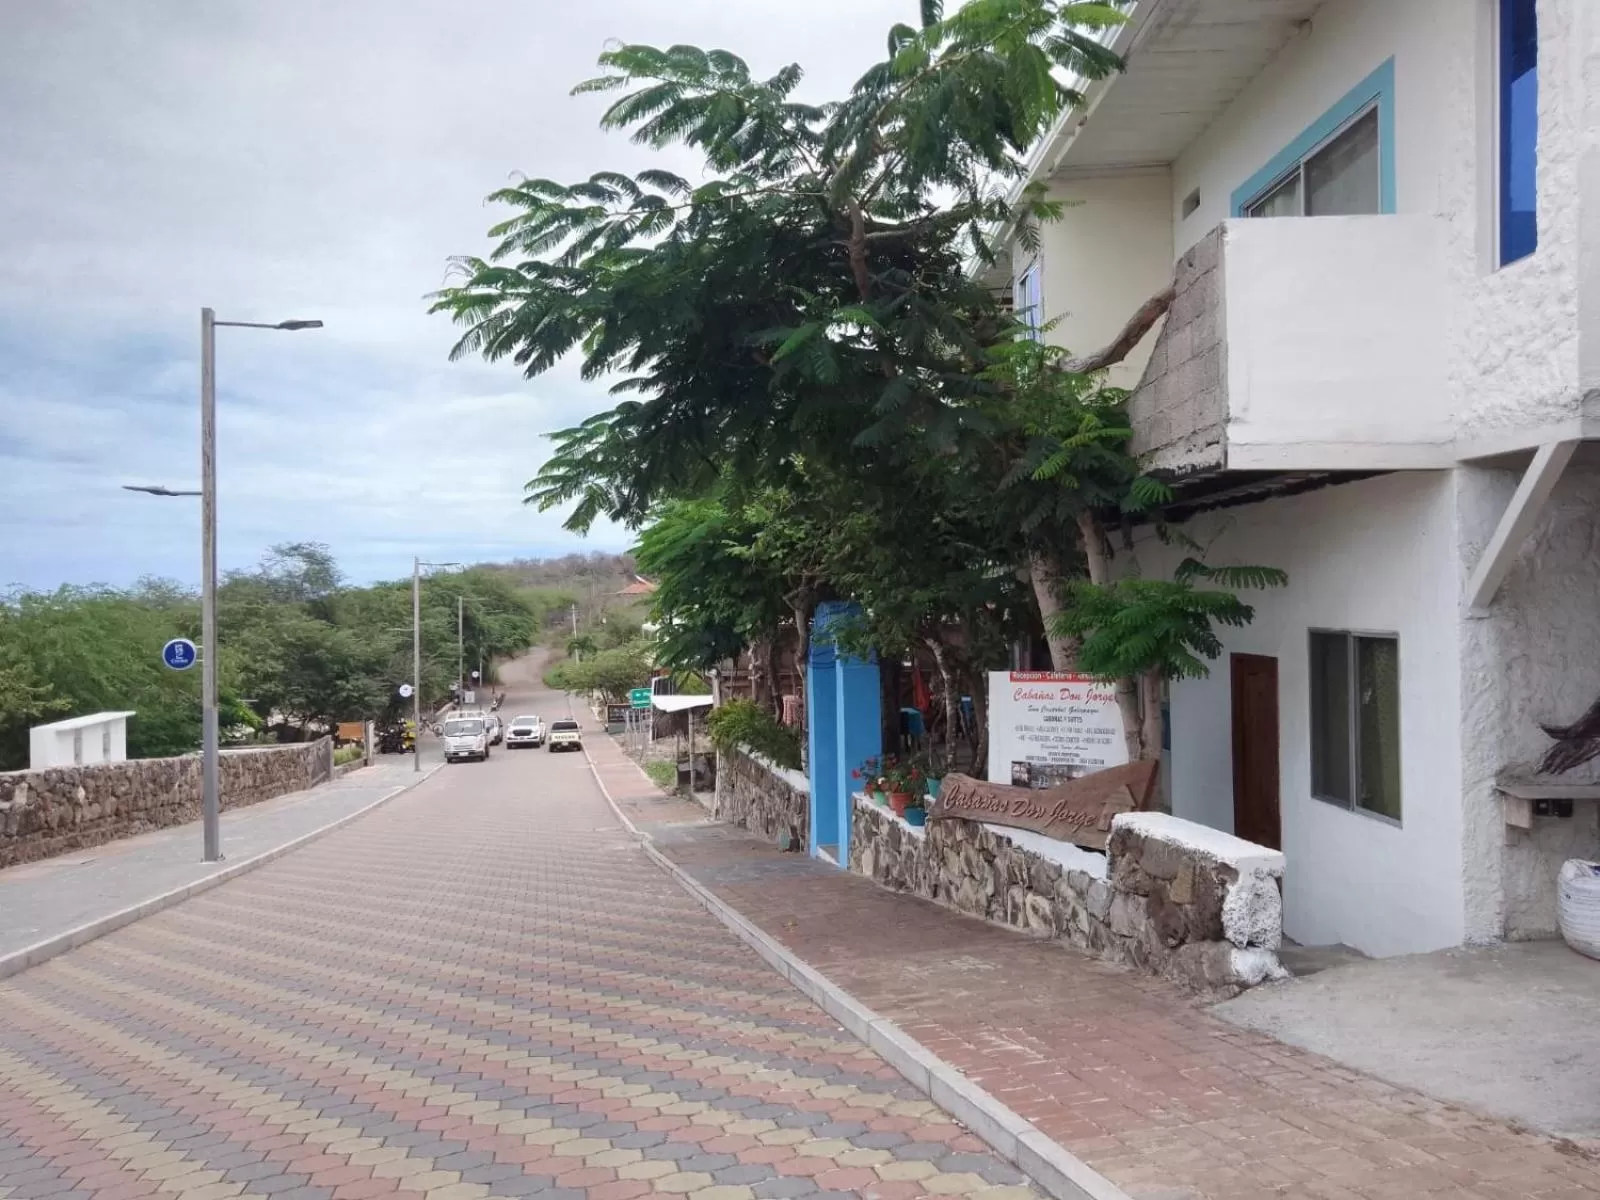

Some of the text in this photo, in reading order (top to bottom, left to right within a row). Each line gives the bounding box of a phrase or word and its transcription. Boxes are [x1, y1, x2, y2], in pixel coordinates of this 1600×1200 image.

[1013, 687, 1116, 706] Cabañas Don Jorge
[943, 782, 1097, 833] Cabañas Don Jorge
